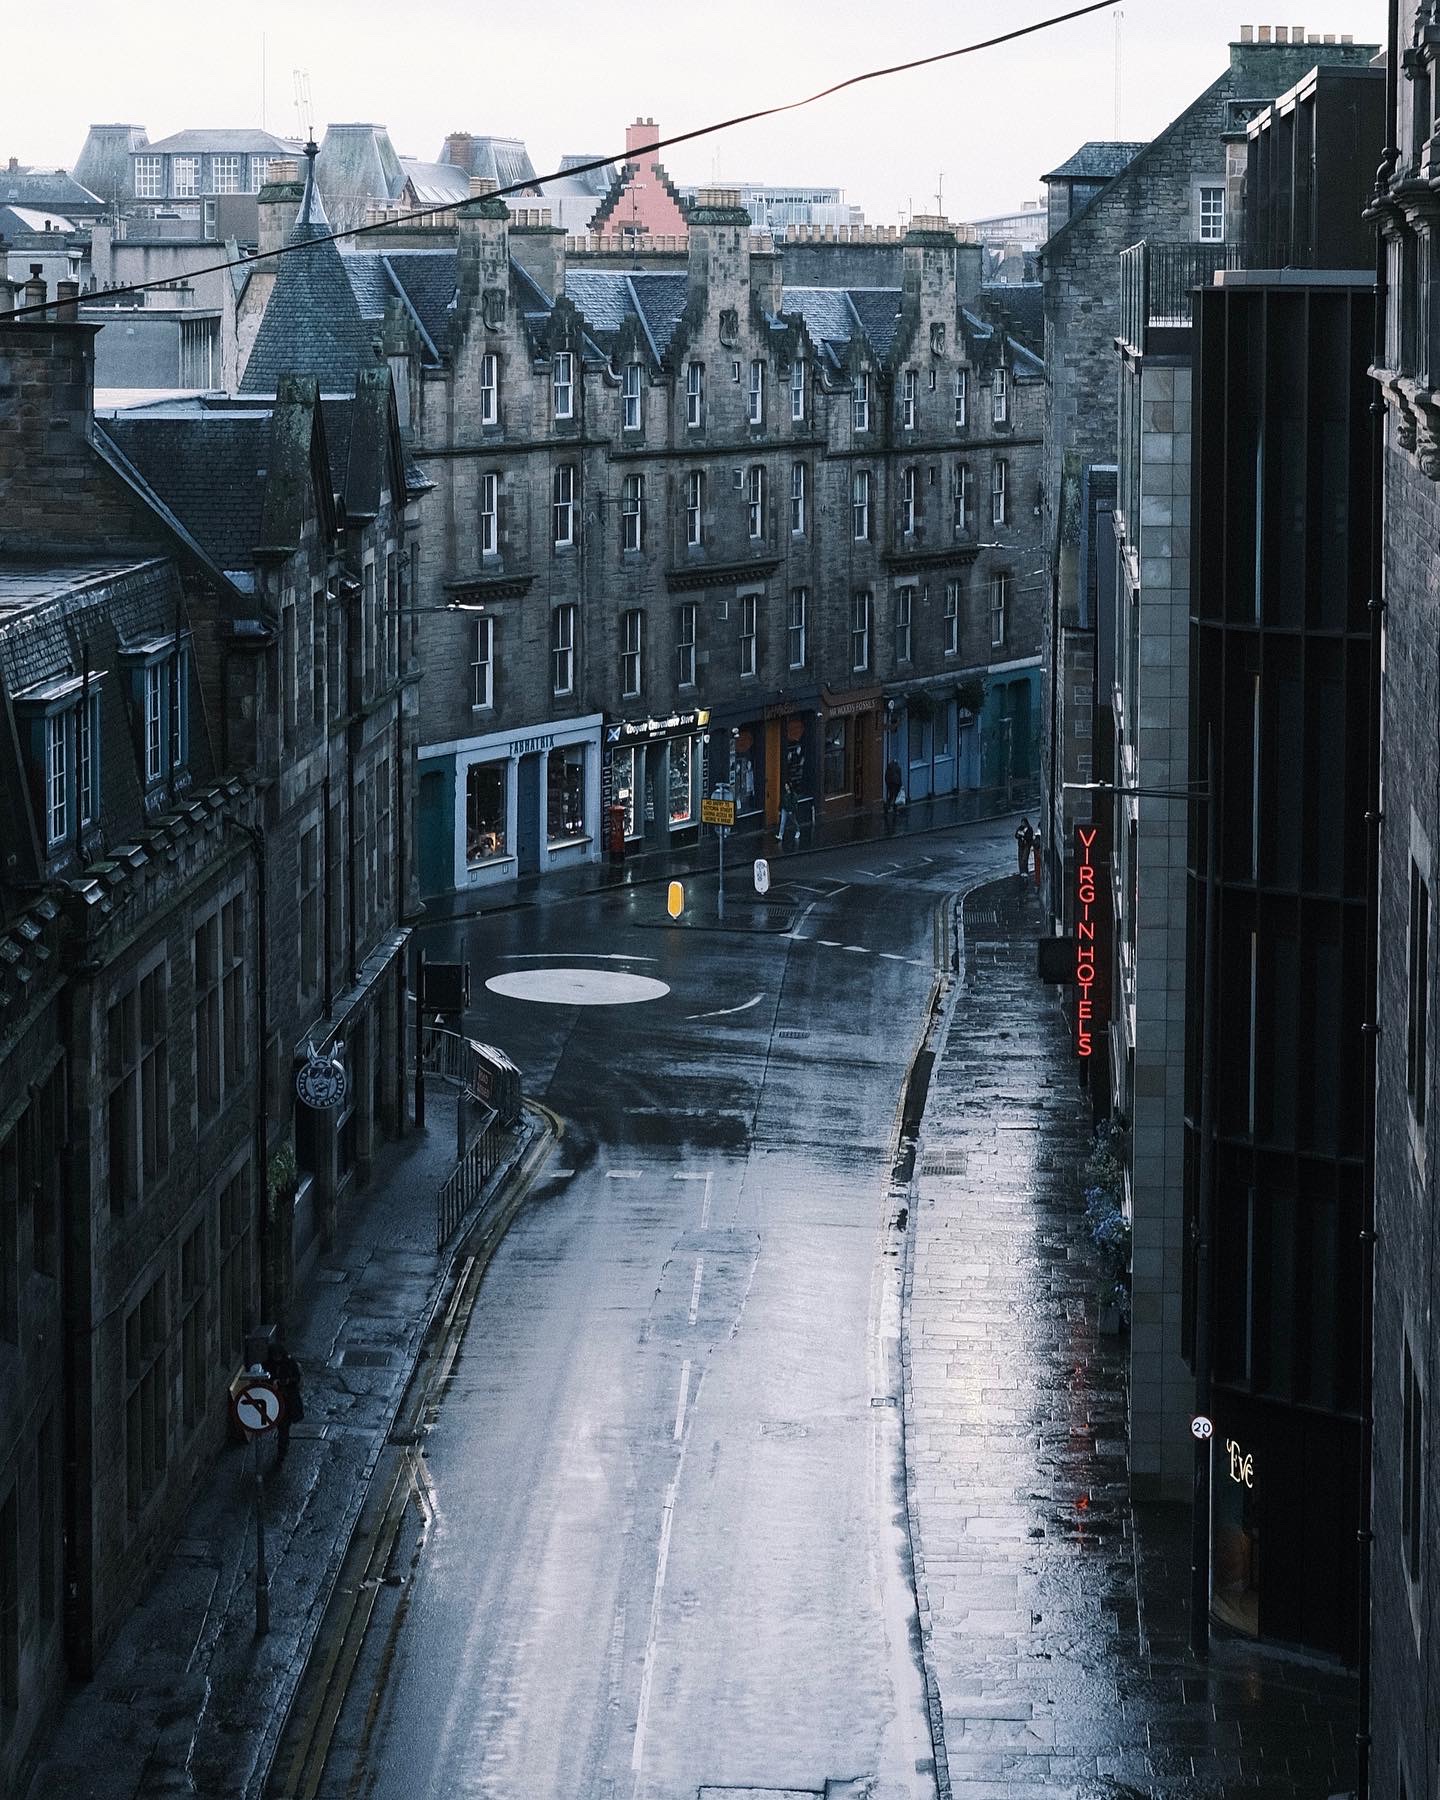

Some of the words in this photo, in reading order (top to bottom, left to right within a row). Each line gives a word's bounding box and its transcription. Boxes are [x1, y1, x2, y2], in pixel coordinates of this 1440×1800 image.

[680, 715, 695, 725] Store
[1078, 828, 1097, 940] VIRGIN
[1076, 945, 1095, 1057] HOTELS
[1194, 1422, 1210, 1433] 20
[1226, 1438, 1254, 1488] Eve
